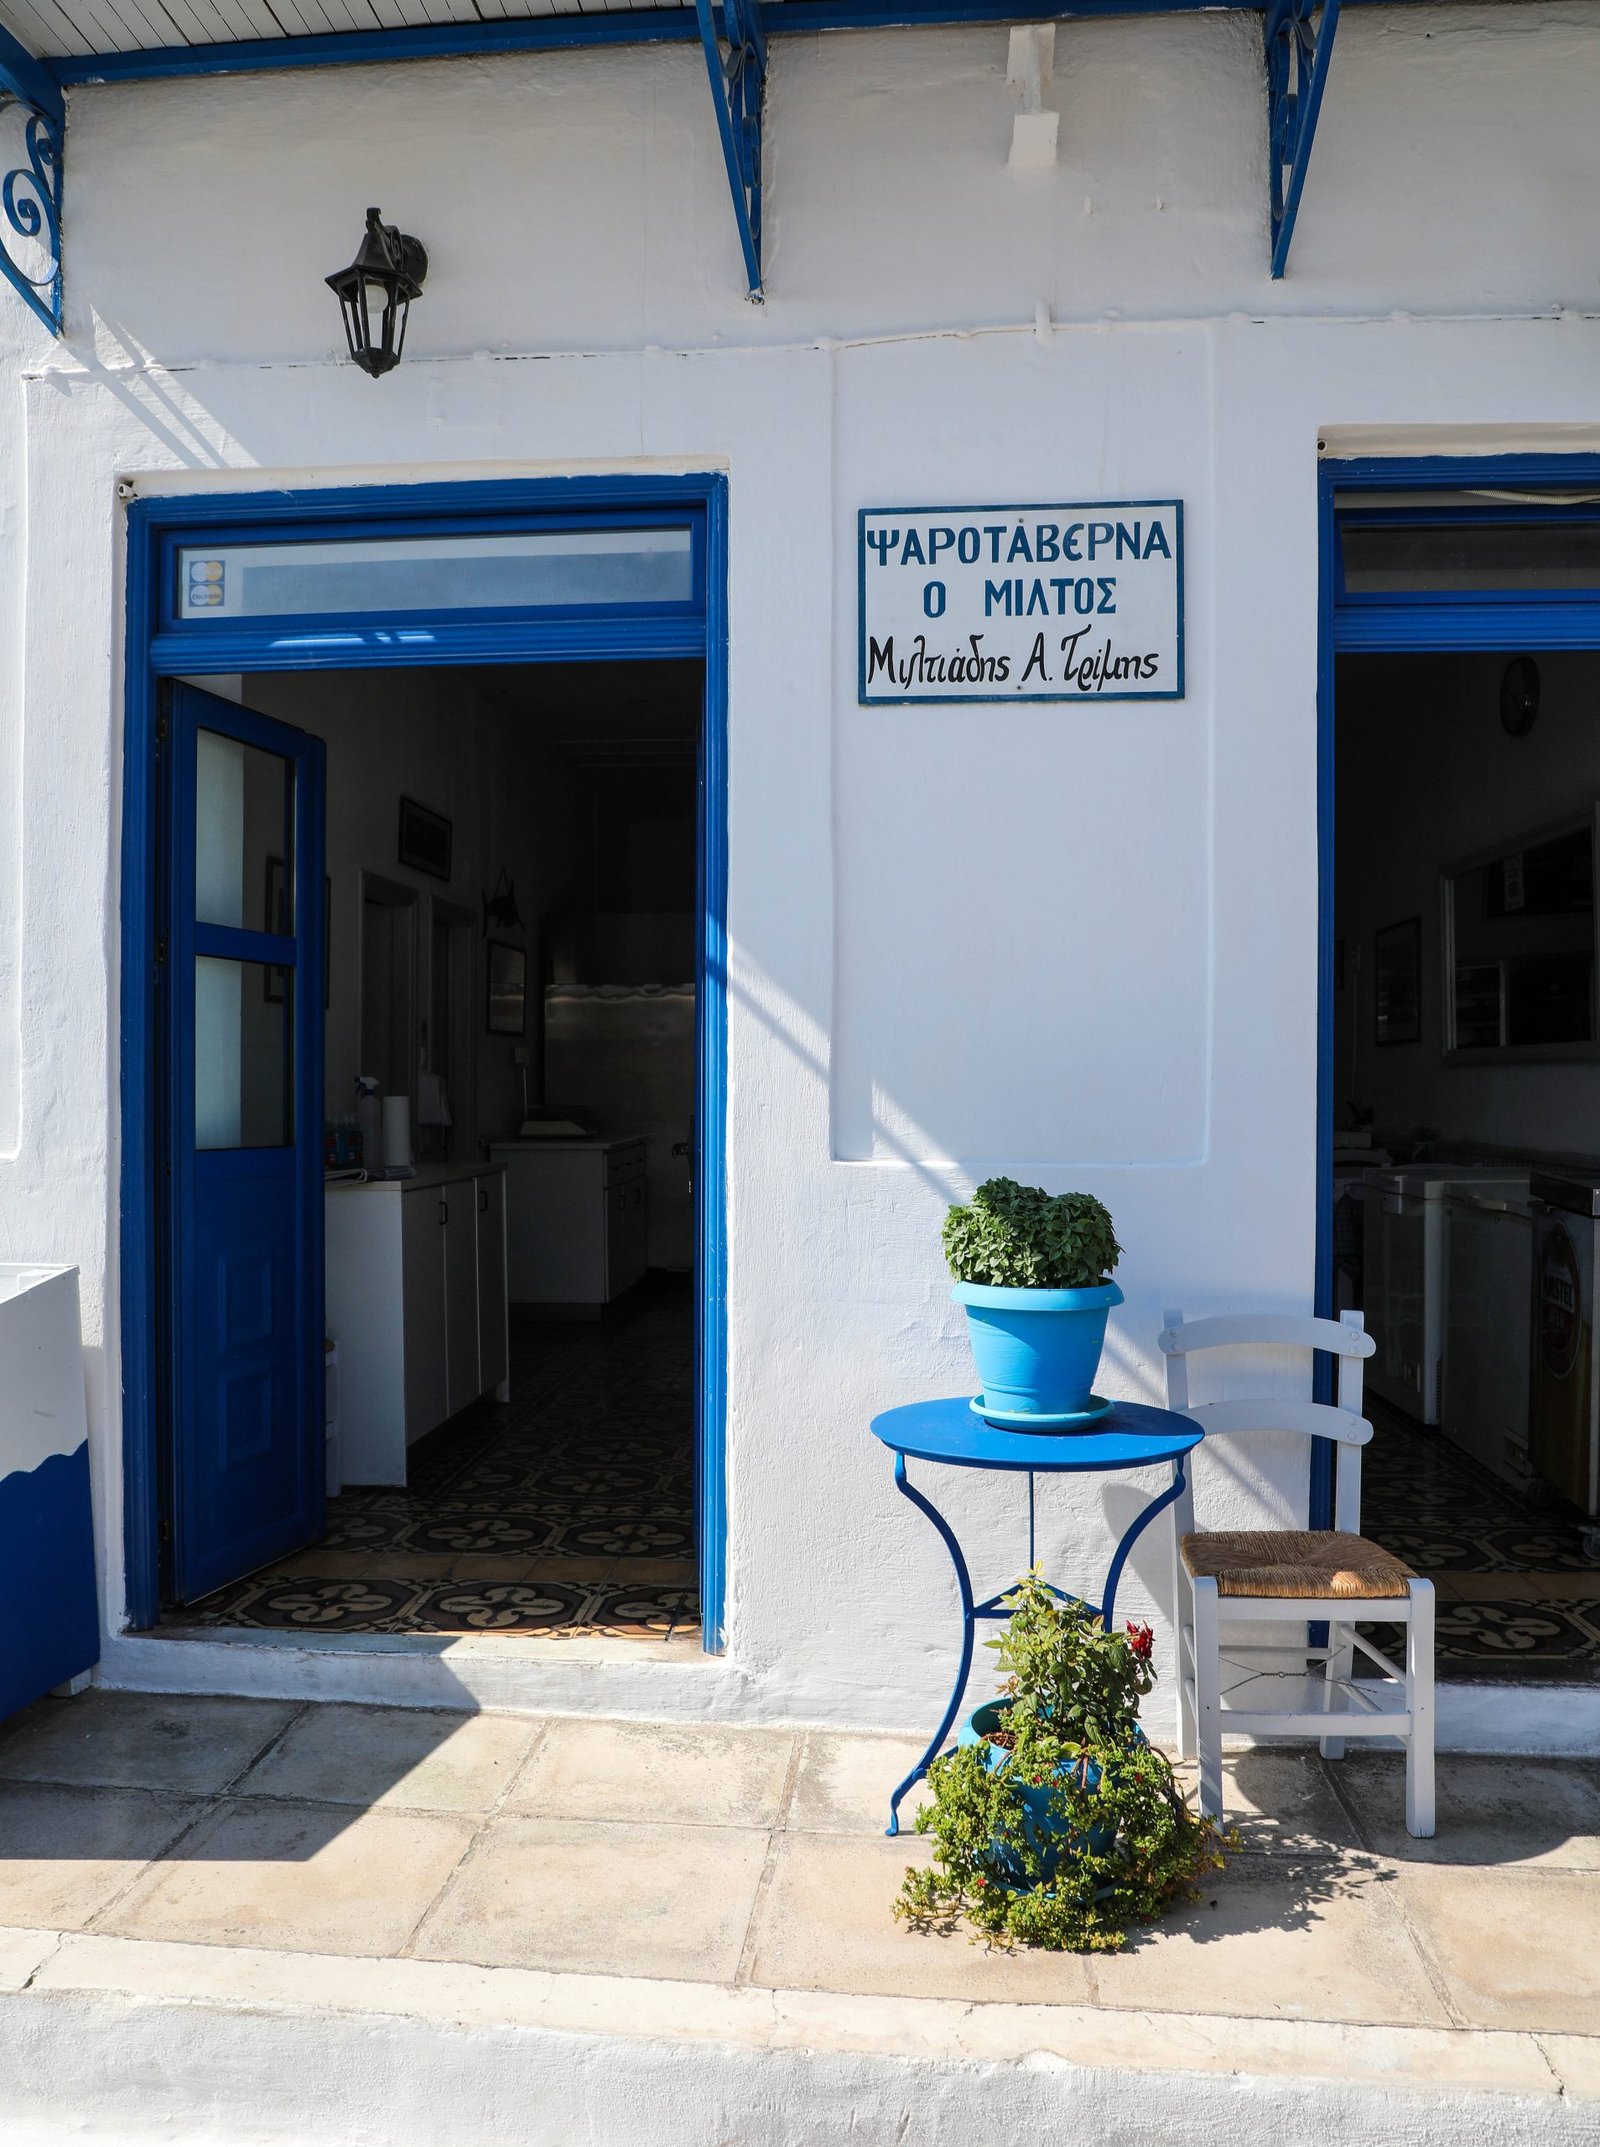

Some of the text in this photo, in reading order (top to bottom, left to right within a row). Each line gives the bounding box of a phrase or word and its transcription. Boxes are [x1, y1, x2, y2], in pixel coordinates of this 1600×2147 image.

[867, 521, 1172, 567] ΨΑΡΟΤΑΒΕΡΝΑ
[923, 577, 1118, 619] Ο ΜΙΛΤΟΣ
[867, 634, 1011, 690] Μιλτιάδης
[1021, 632, 1053, 682] Α.
